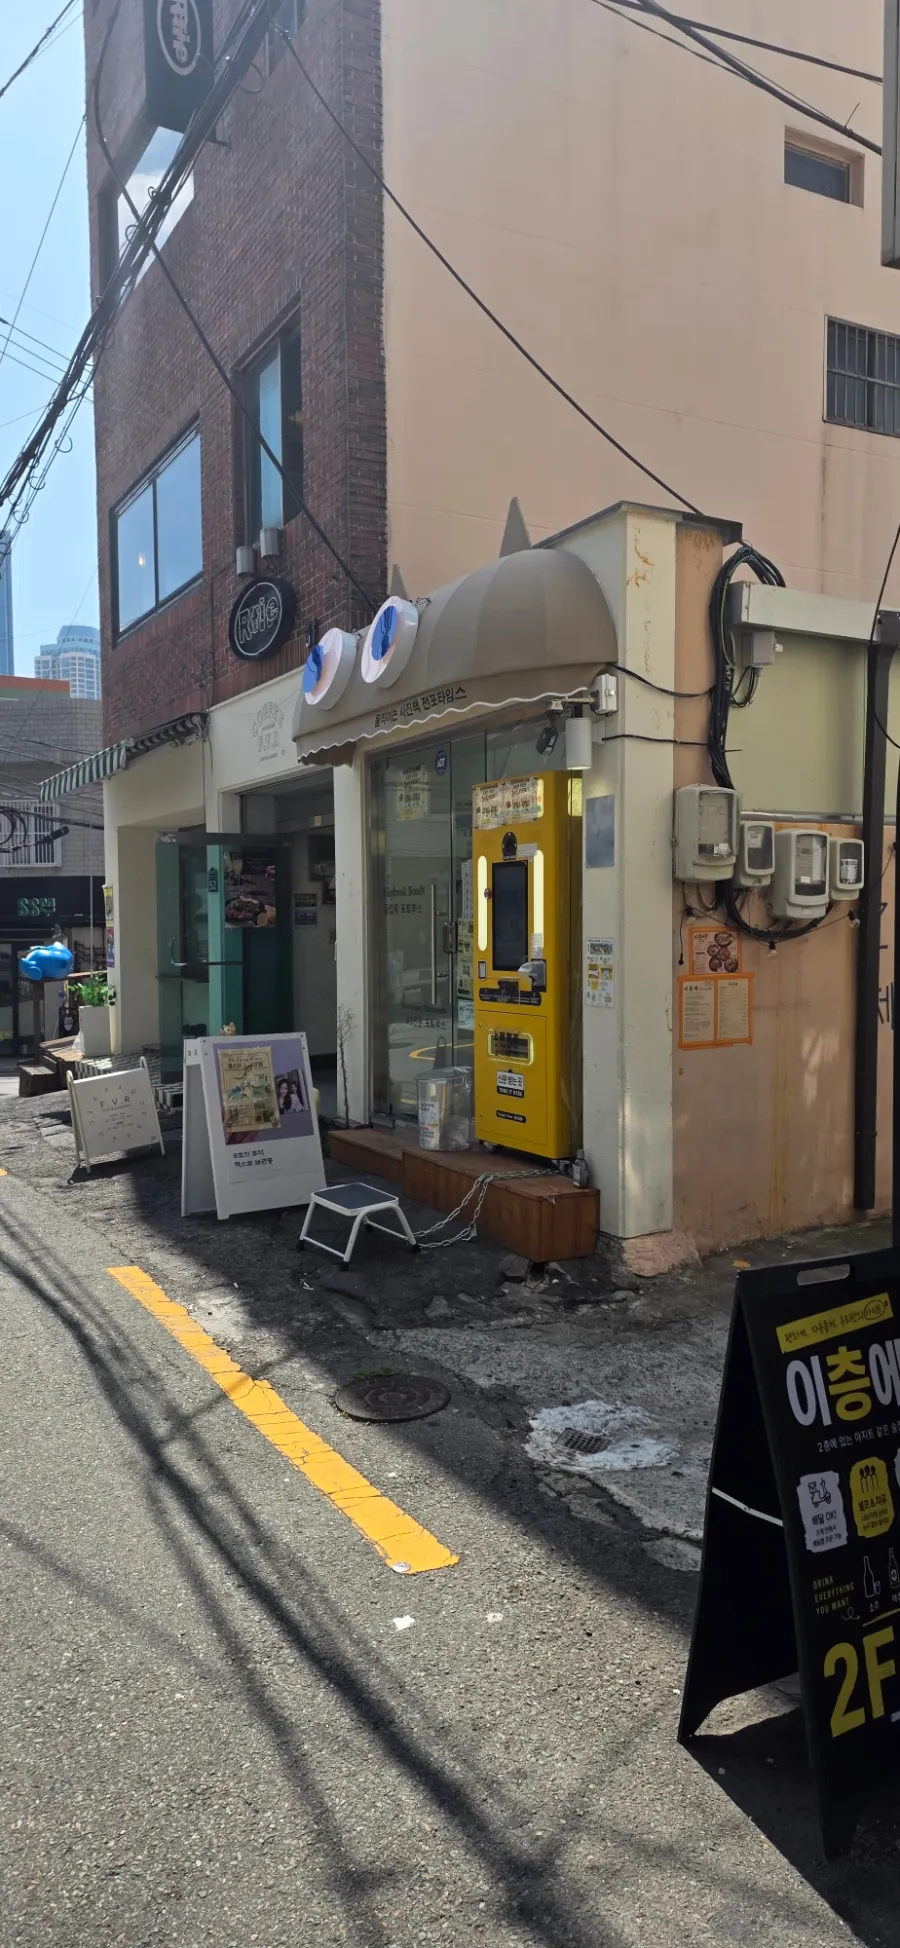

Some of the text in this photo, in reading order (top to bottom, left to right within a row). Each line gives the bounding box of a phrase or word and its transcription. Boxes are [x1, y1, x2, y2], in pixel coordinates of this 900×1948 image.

[375, 686, 467, 728] 움직이는 사진책 전포타임스
[401, 903, 422, 913] 포토부스
[817, 1438, 838, 1453] 2층에
[839, 1435, 853, 1447] 있는
[854, 1428, 874, 1442] 아지트
[876, 1424, 890, 1438] 같은
[812, 1510, 837, 1525] 배달 OK!
[813, 1576, 834, 1590] DRINK
[815, 1582, 854, 1603] EVERYTHING
[816, 1597, 849, 1616] YOU WANT
[869, 1600, 880, 1613] 소주
[824, 1626, 896, 1738] 2F
